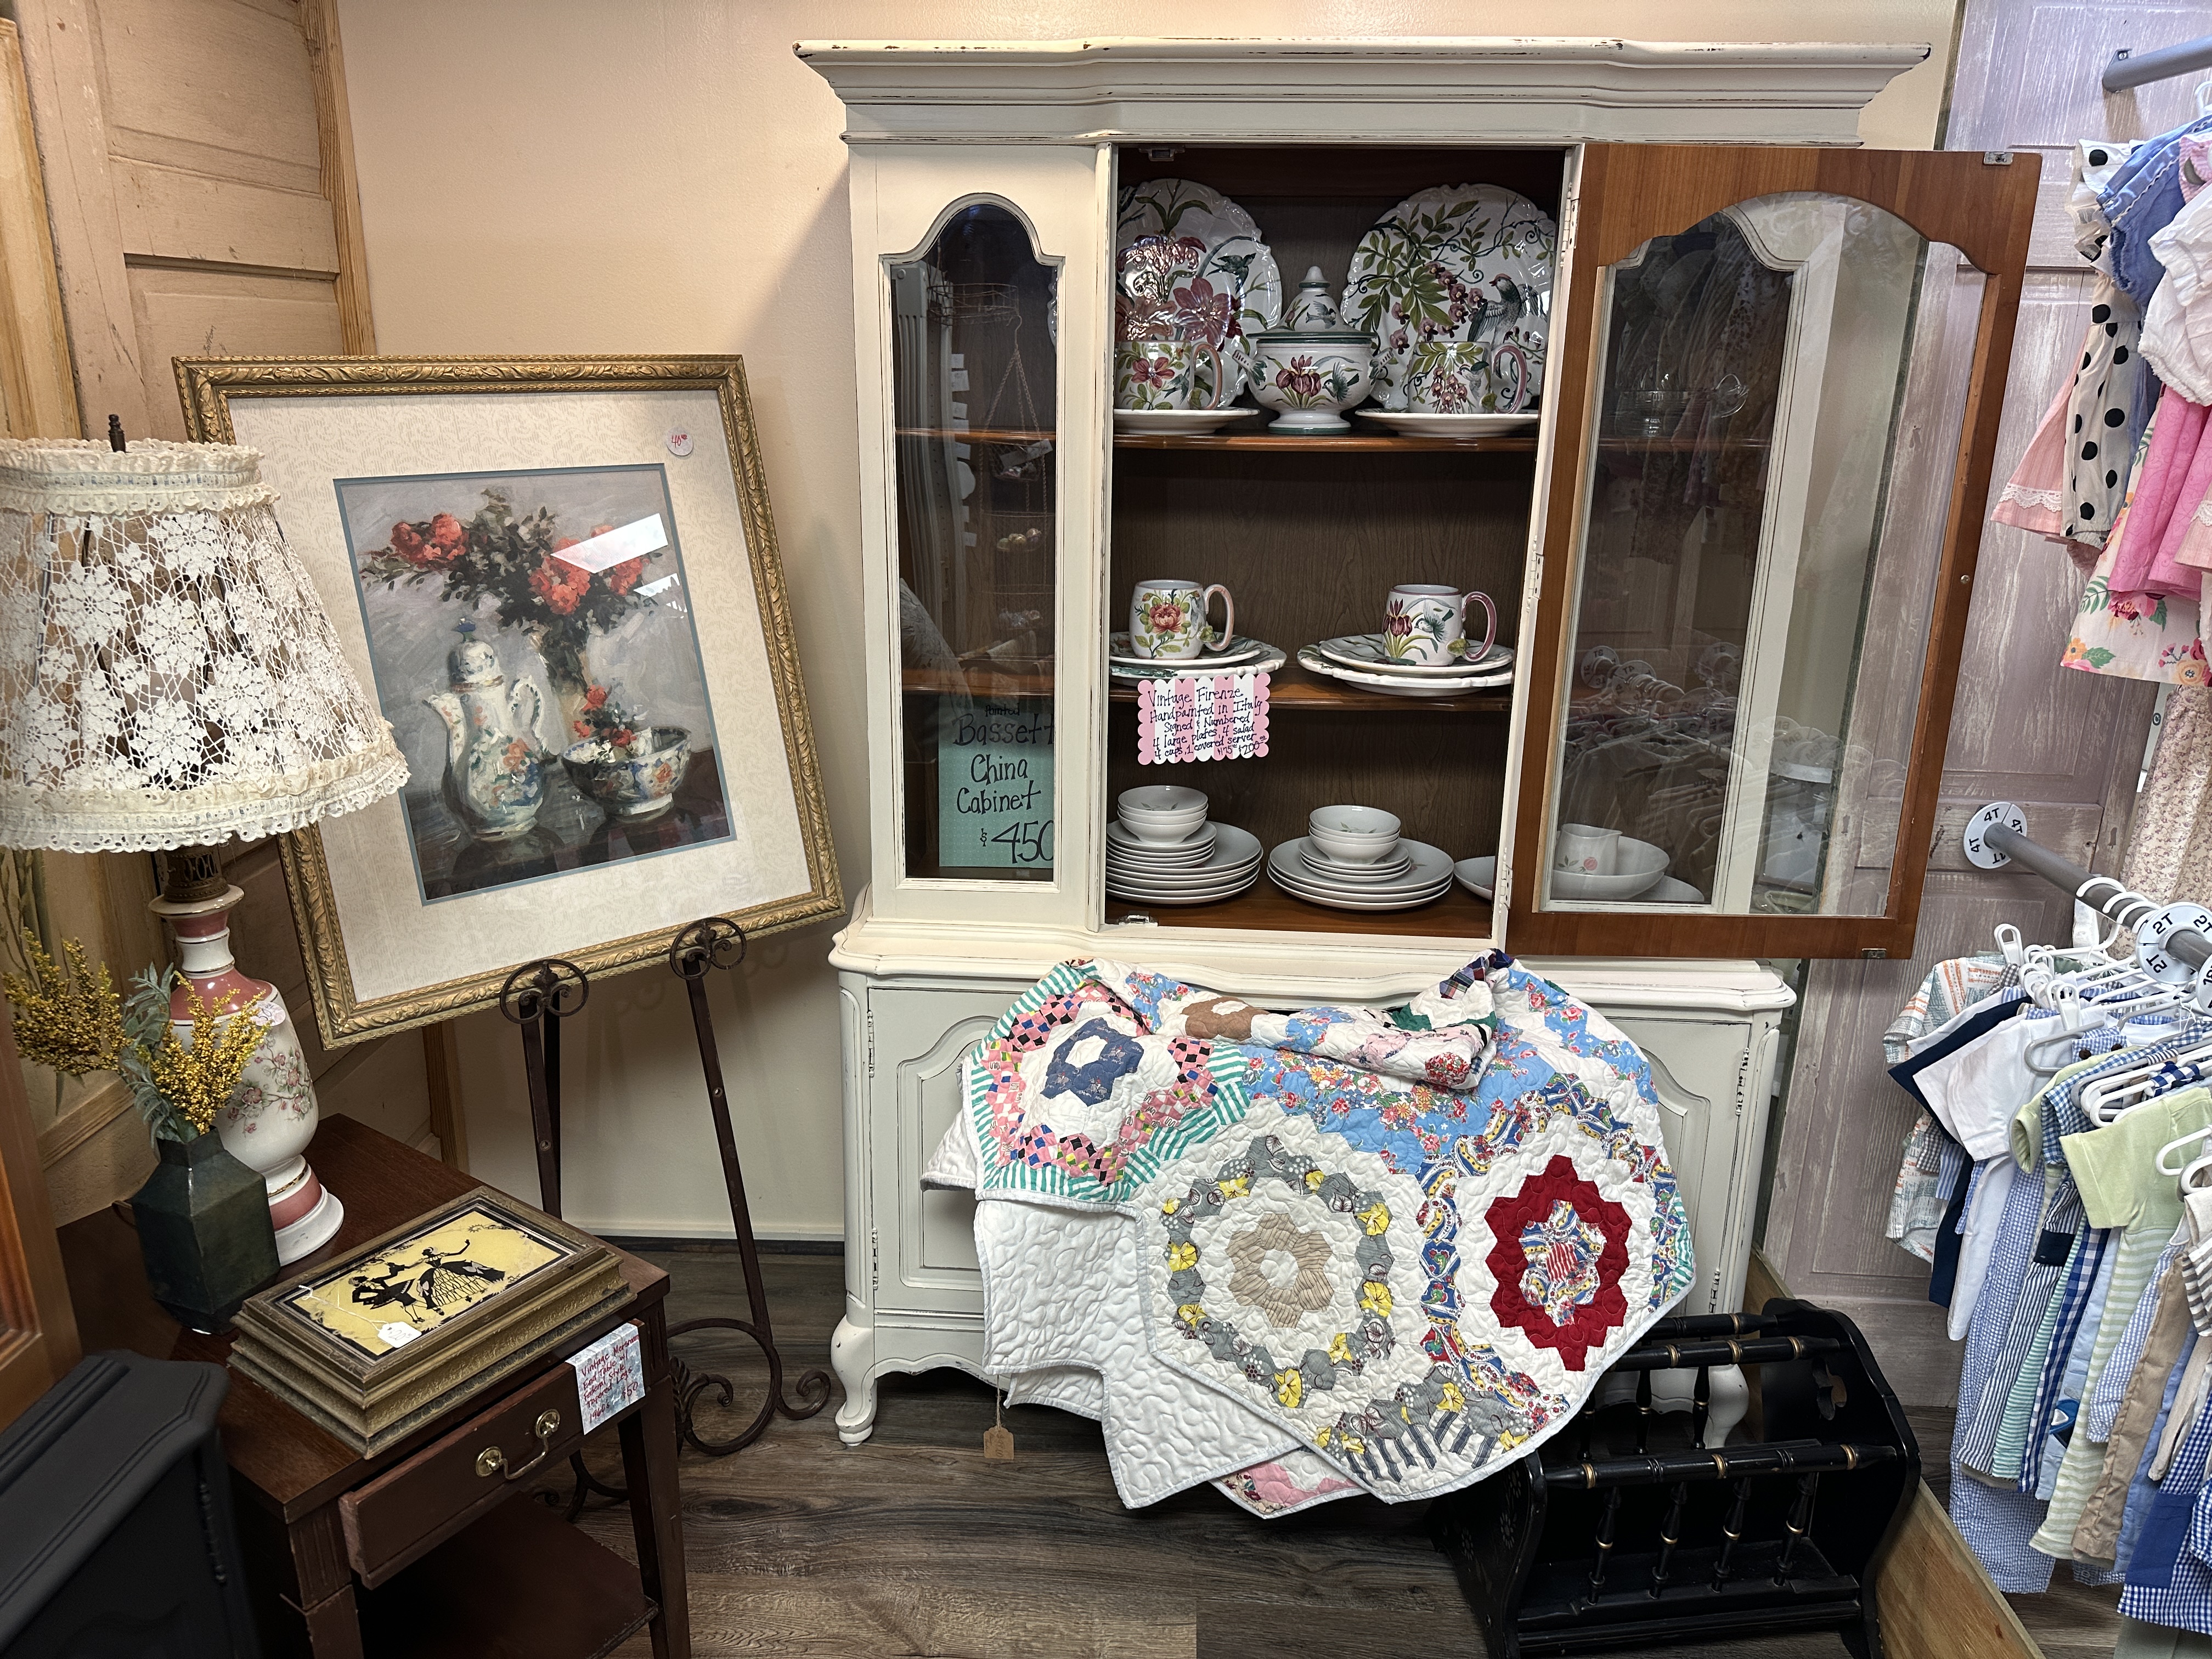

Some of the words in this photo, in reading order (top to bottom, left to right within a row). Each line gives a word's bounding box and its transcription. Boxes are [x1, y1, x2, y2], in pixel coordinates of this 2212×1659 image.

[1148, 689, 1192, 709] Vintage
[1197, 686, 1244, 702] Firenze
[1150, 702, 1214, 723] Handpainted
[1218, 702, 1228, 715] in
[1233, 696, 1263, 716] Italy
[952, 713, 1054, 746] Bassett
[1153, 737, 1160, 750] 4
[1164, 735, 1187, 750] large
[1223, 725, 1229, 736] 4
[1233, 721, 1255, 735] salad
[1164, 718, 1193, 736] Signed
[1204, 712, 1250, 727] Numbered
[1155, 749, 1161, 760] 4
[1194, 736, 1224, 751] covered
[1227, 733, 1257, 744] server
[970, 754, 1028, 786] China
[957, 780, 1041, 814] Cabinet
[1984, 807, 2000, 822] 4T
[1969, 838, 1980, 853] 4T
[2152, 912, 2173, 935] 2T
[2146, 954, 2168, 974] 2T
[581, 1353, 610, 1377] Vintage
[583, 1374, 597, 1390] End
[598, 1359, 617, 1377] Table
[584, 1376, 606, 1402] Federal
[609, 1364, 626, 1380] Style
[586, 1379, 612, 1408] Tapered
[616, 1366, 633, 1384] Legs
[589, 1398, 610, 1424] 1960's
[622, 1381, 639, 1400] $50
